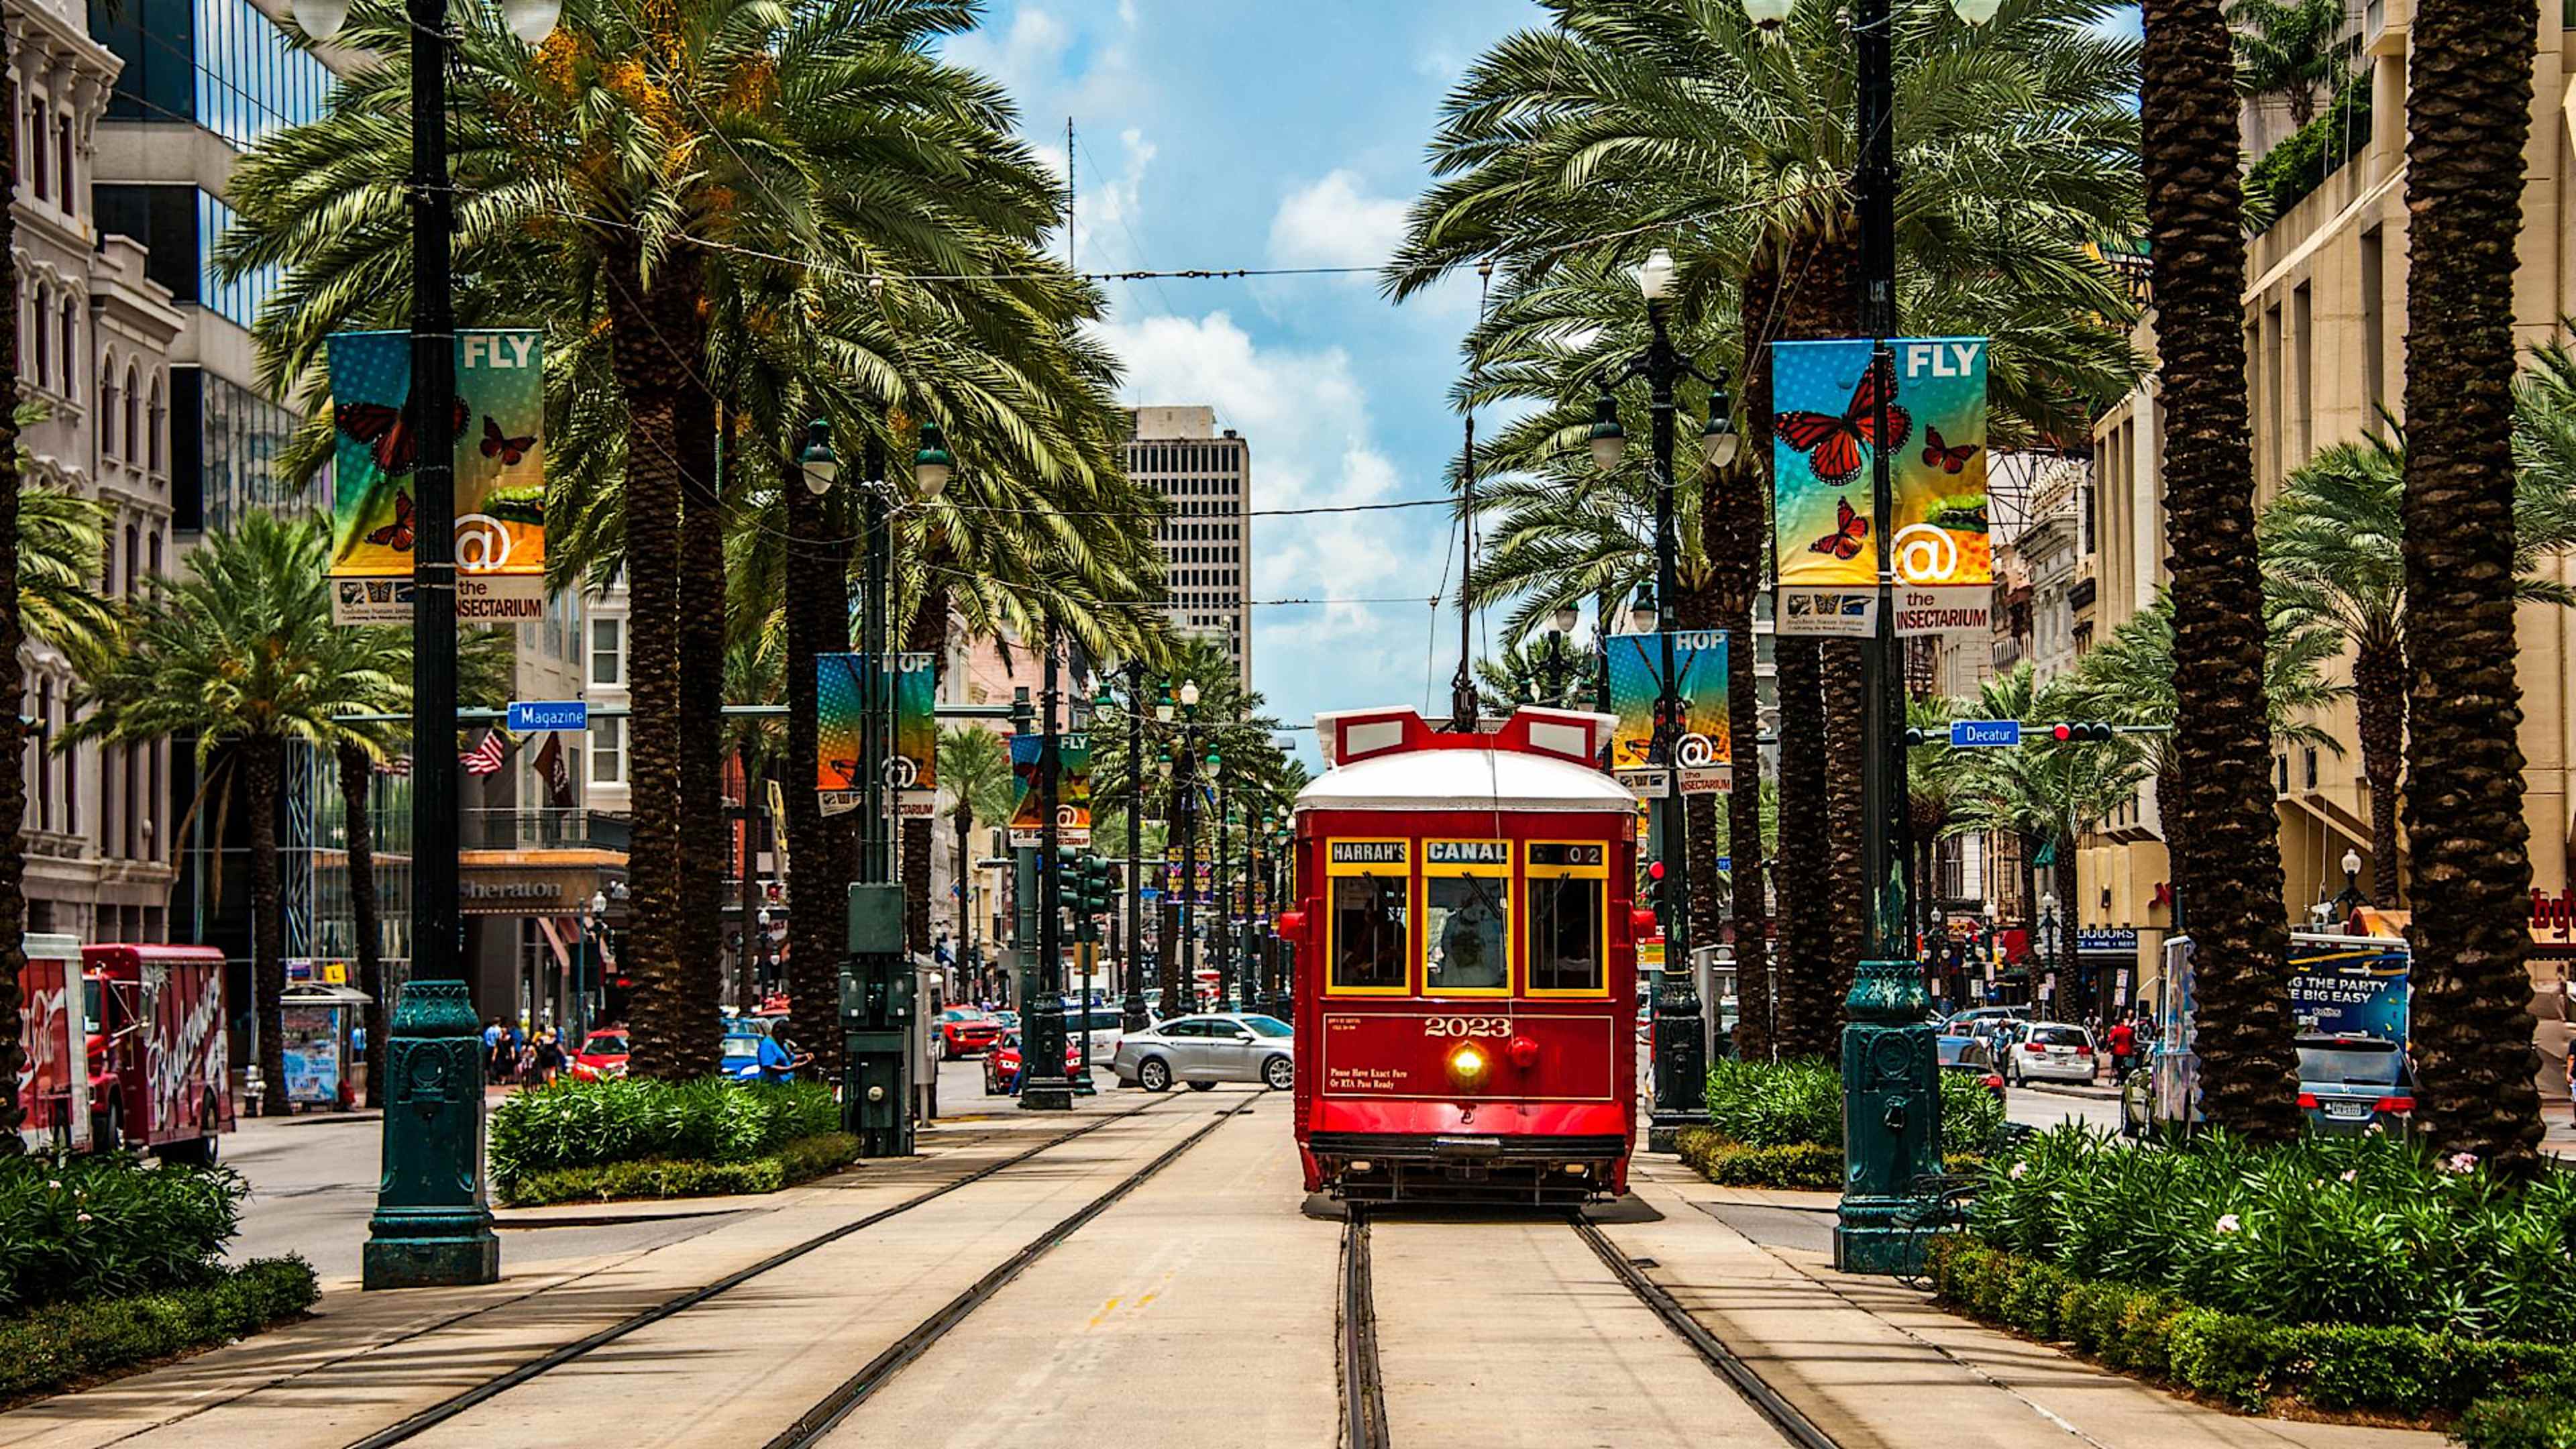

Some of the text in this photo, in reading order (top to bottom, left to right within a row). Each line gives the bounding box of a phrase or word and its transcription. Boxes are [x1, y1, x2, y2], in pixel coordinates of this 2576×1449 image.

[463, 335, 536, 368] FLY
[1907, 343, 1981, 377] FLY
[1890, 523, 1957, 585] @
[458, 580, 488, 596] the
[1907, 592, 1935, 606] the
[1896, 608, 1987, 630] INSECTARIUM
[1676, 633, 1726, 651] HOP
[521, 706, 584, 727] Magazine
[1966, 725, 2011, 741] Decatur
[1061, 737, 1087, 749] FLY
[1676, 733, 1713, 769] @
[1334, 844, 1405, 861] HARRAH'S
[1429, 843, 1506, 859] CANAL
[2306, 977, 2336, 989] THE
[2339, 979, 2388, 992] PARTY
[2304, 989, 2328, 1001] BIG
[2332, 991, 2371, 1004] EASY
[1424, 1017, 1511, 1038] 2023
[1330, 1067, 1407, 1078] Please Have Exact Fare
[1340, 1078, 1355, 1088] RTA
[1373, 1079, 1394, 1090] Ready
